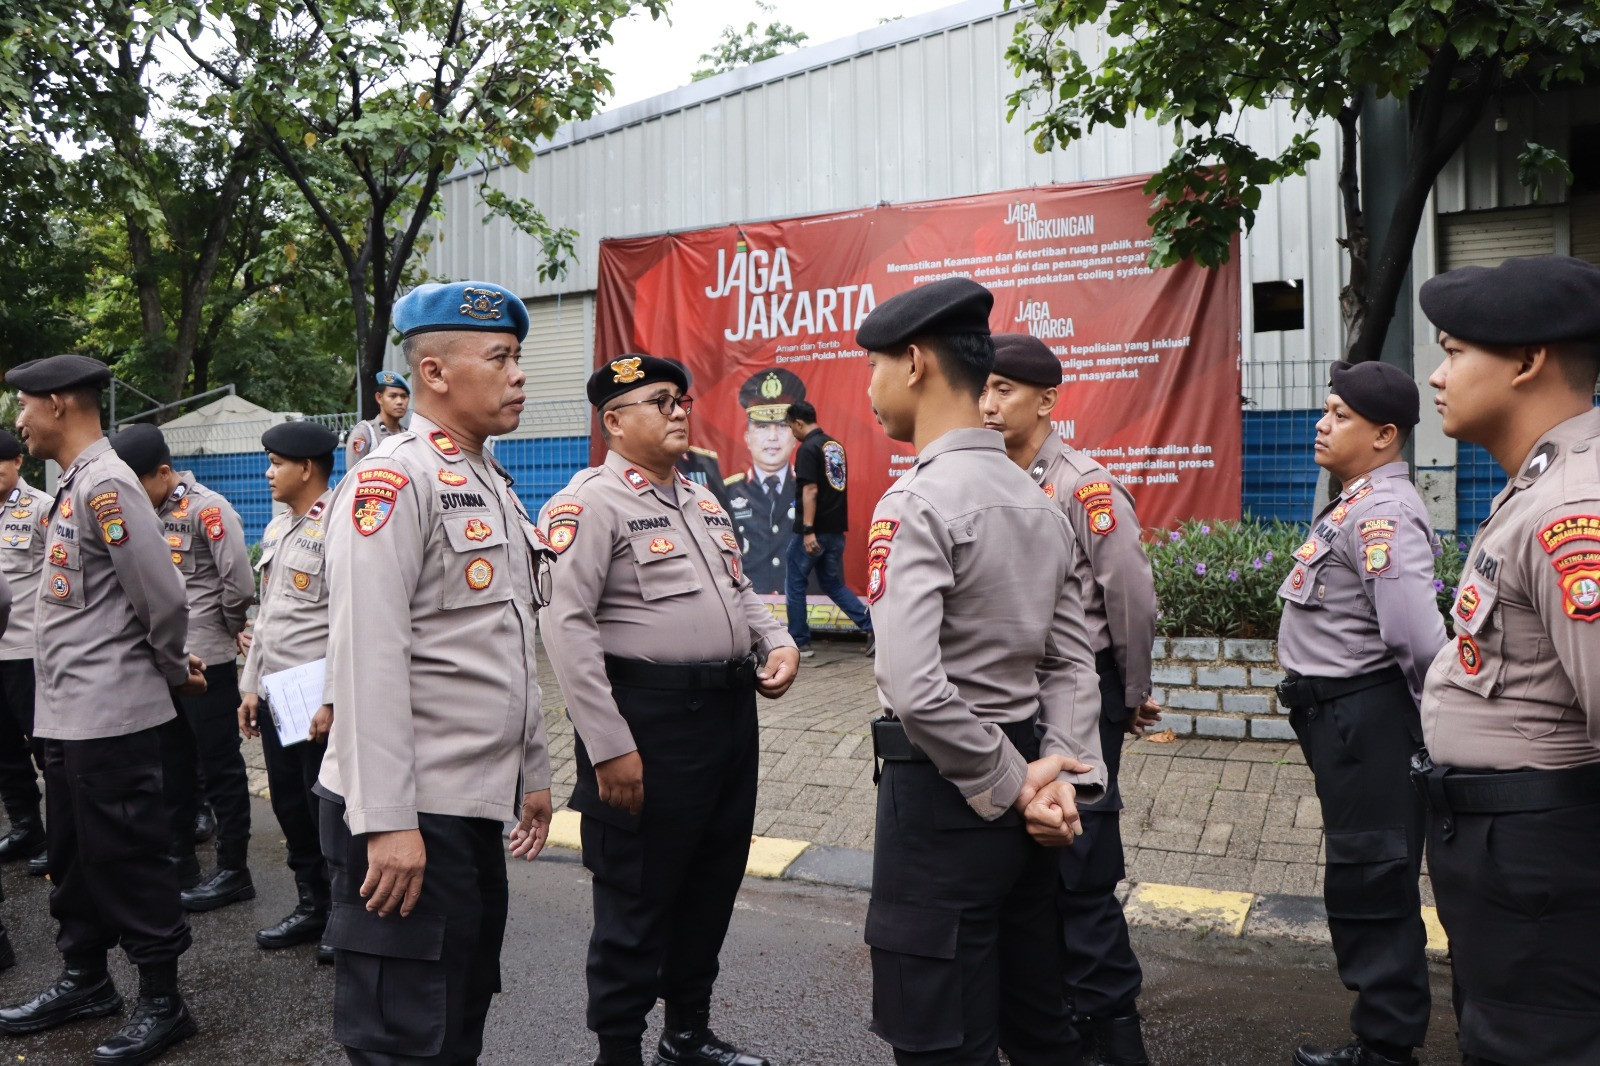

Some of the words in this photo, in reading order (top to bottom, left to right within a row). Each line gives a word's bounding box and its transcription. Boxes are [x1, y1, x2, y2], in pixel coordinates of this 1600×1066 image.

[1004, 203, 1037, 224] JAGA
[1018, 215, 1094, 242] LINGKUNGAN
[886, 260, 941, 273] Memastikan
[944, 255, 993, 267] Keamanan
[995, 252, 1013, 262] dan
[1015, 246, 1067, 260] Ketertiban
[1069, 243, 1098, 255] ruang
[1101, 239, 1132, 253] publik
[705, 247, 793, 298] JAGA
[974, 266, 1010, 277] deteksi
[1012, 263, 1029, 273] dini
[1032, 261, 1050, 272] dan
[1052, 255, 1113, 271] penanganan
[1115, 252, 1145, 264] cepat
[1017, 272, 1074, 288] pendekatan
[1077, 268, 1114, 281] cooling
[724, 283, 876, 342] JAKARTA
[1014, 301, 1050, 323] JAGA
[1028, 317, 1075, 339] WARGA
[776, 344, 799, 352] Aman
[800, 342, 816, 351] dan
[817, 339, 840, 349] Tertib
[1071, 343, 1122, 356] kepolisian
[1124, 341, 1150, 353] yang
[1152, 336, 1190, 349] inklusif
[776, 354, 811, 364] Bersama
[812, 352, 836, 361] Polda
[838, 349, 864, 359] Metro
[1096, 353, 1159, 367] mempererat
[1079, 368, 1139, 382] masyarakat
[1128, 444, 1190, 457] berkeadilan
[1192, 443, 1212, 454] dan
[1106, 460, 1176, 472] pengendalian
[1178, 459, 1215, 470] proses
[373, 470, 404, 486] PROPAM
[1146, 473, 1179, 486] publik
[359, 488, 393, 497] PROPAM
[5, 523, 31, 532] POLRI
[165, 522, 190, 533] POLRI
[627, 516, 672, 533] KUSNADI
[704, 515, 731, 528] POLRI
[1542, 517, 1600, 542] POLRE
[56, 523, 74, 540] POLRI
[295, 537, 323, 552] POLRI
[1558, 554, 1583, 568] METRO
